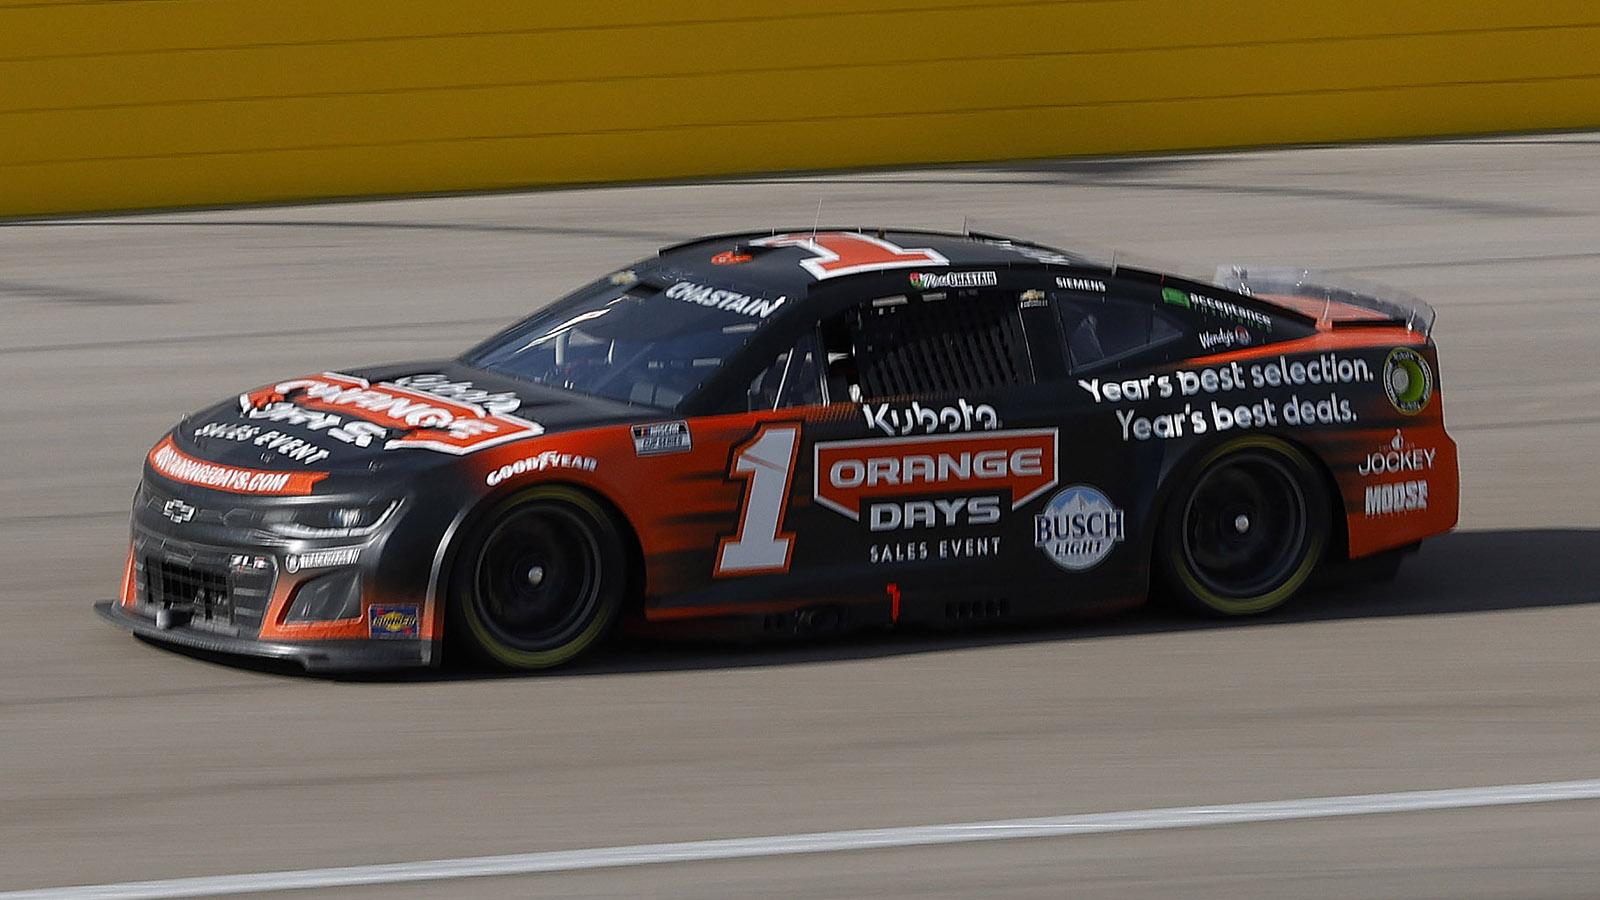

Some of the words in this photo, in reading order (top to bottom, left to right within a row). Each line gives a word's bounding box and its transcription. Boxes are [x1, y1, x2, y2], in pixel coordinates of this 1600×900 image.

[747, 232, 950, 281] 1
[946, 270, 998, 288] CHASTAIN
[1055, 276, 1107, 293] SIEMENS
[665, 281, 787, 318] CHASTAIN
[1198, 327, 1236, 350] Wendy's
[1078, 373, 1173, 403] Year's
[1176, 361, 1248, 396] best
[1250, 353, 1374, 388] selection.
[862, 398, 998, 437] Kubota
[1115, 403, 1208, 441] Year's
[1211, 397, 1279, 432] best
[1282, 393, 1358, 426] deals.
[485, 450, 599, 487] GOODYEAR
[829, 448, 1043, 488] ORANGE
[1358, 447, 1437, 477] JOCKEY
[713, 422, 800, 577] 1
[869, 496, 1001, 532] DAYS
[1364, 480, 1429, 516] MOOSE
[1036, 511, 1122, 542] BUSCH
[869, 542, 928, 564] SALES
[938, 536, 1001, 558] EVENT
